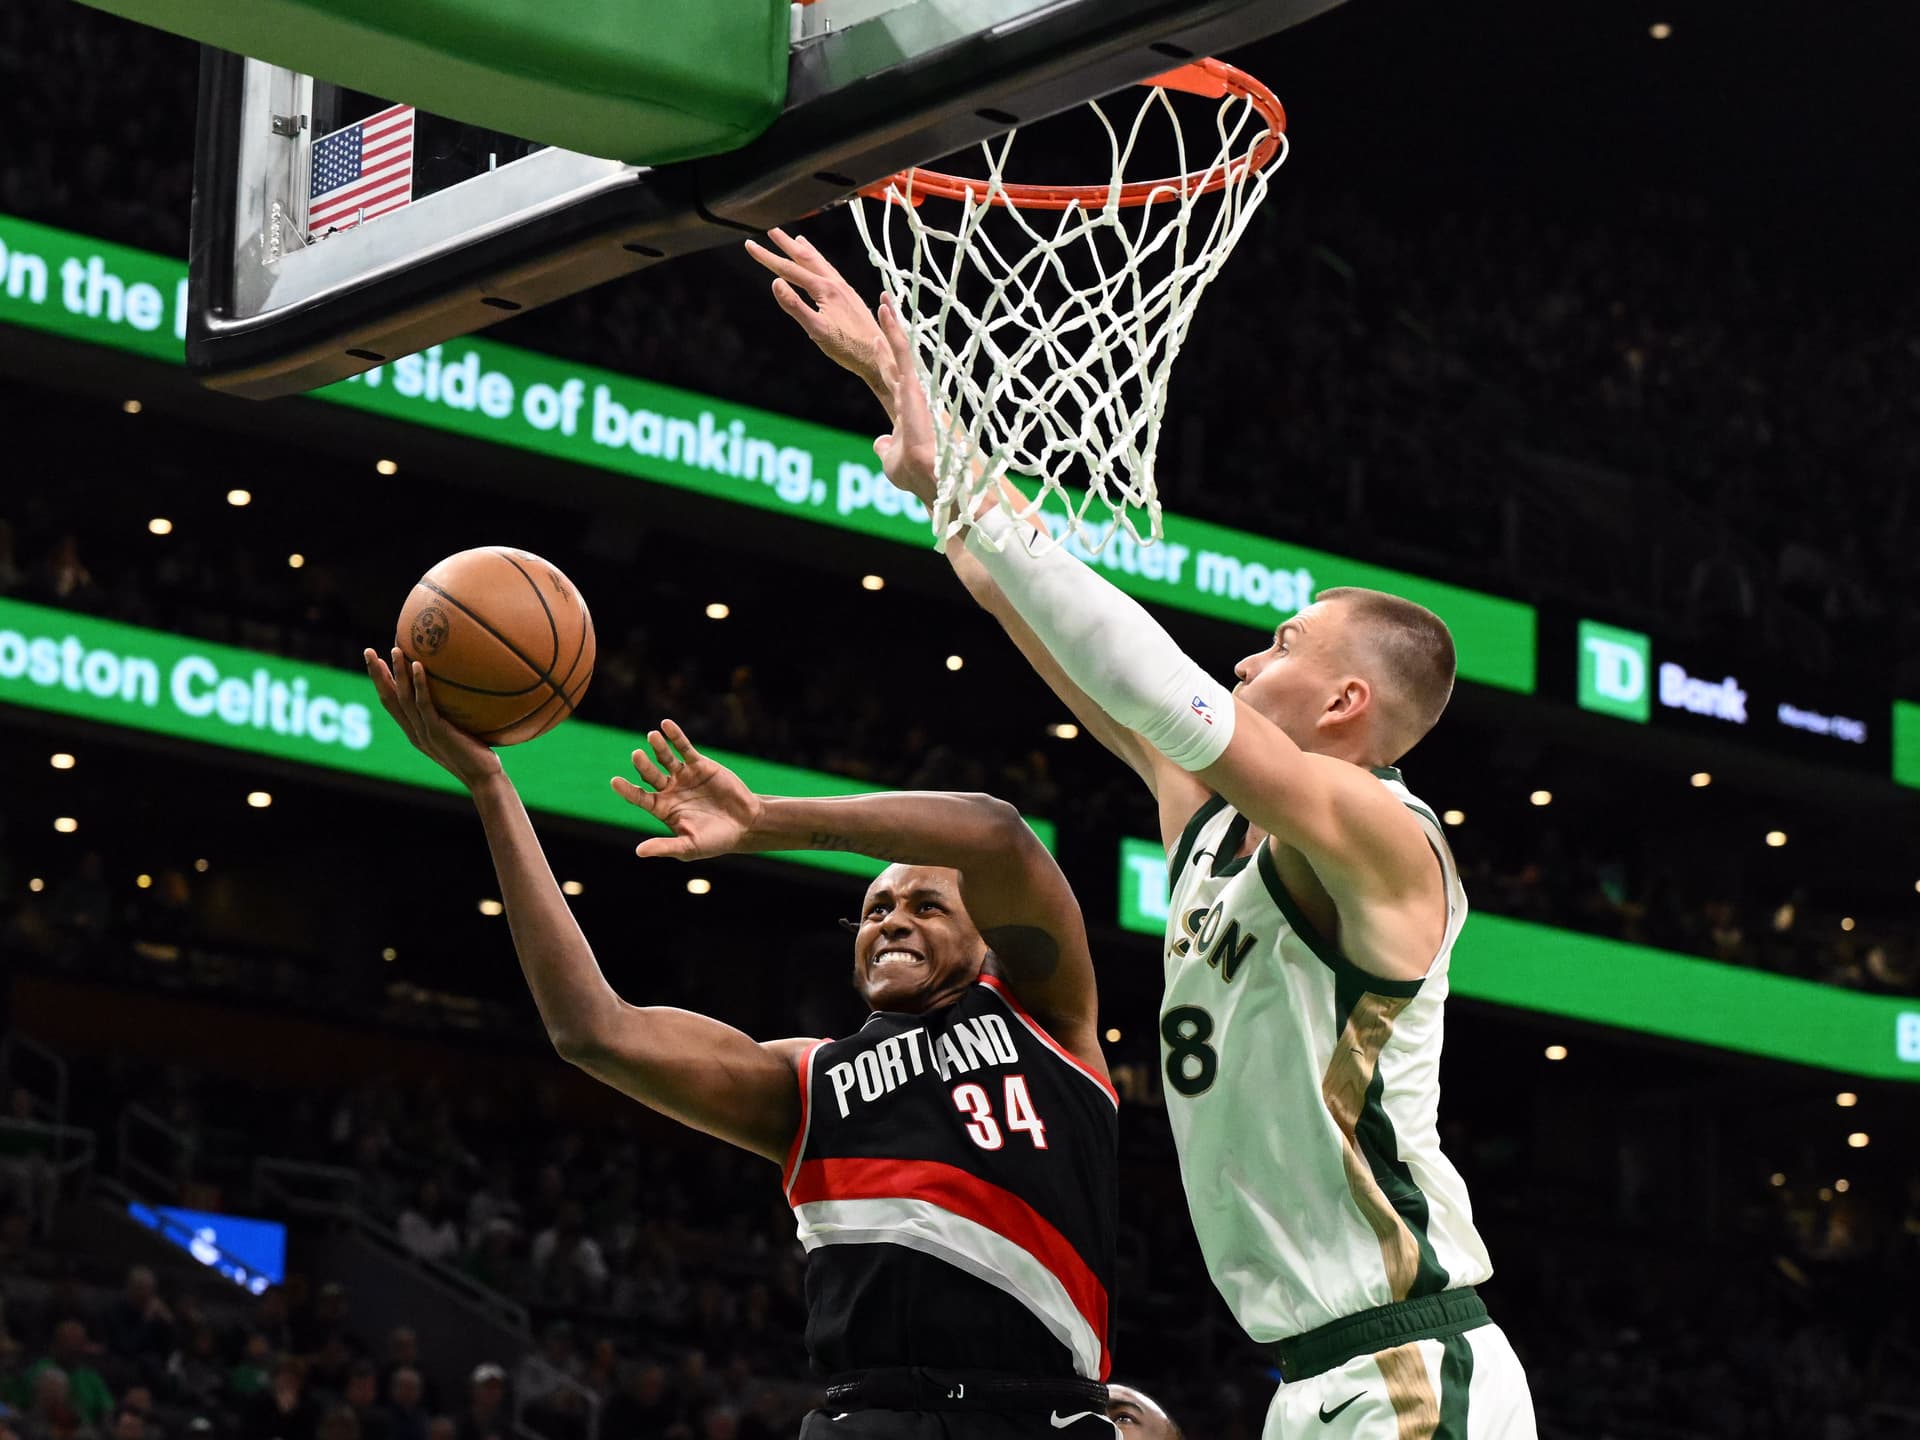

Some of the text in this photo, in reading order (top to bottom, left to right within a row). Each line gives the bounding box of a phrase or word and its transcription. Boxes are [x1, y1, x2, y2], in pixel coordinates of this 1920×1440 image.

[0, 237, 48, 304] n
[60, 255, 164, 331] the
[392, 344, 513, 418] side
[523, 377, 585, 436] of
[592, 384, 827, 506] banking,
[1196, 548, 1315, 614] most
[170, 655, 373, 751] Celtics
[1584, 637, 1646, 704] TD
[1160, 1004, 1218, 1098] 8
[951, 1073, 1049, 1151] 34
